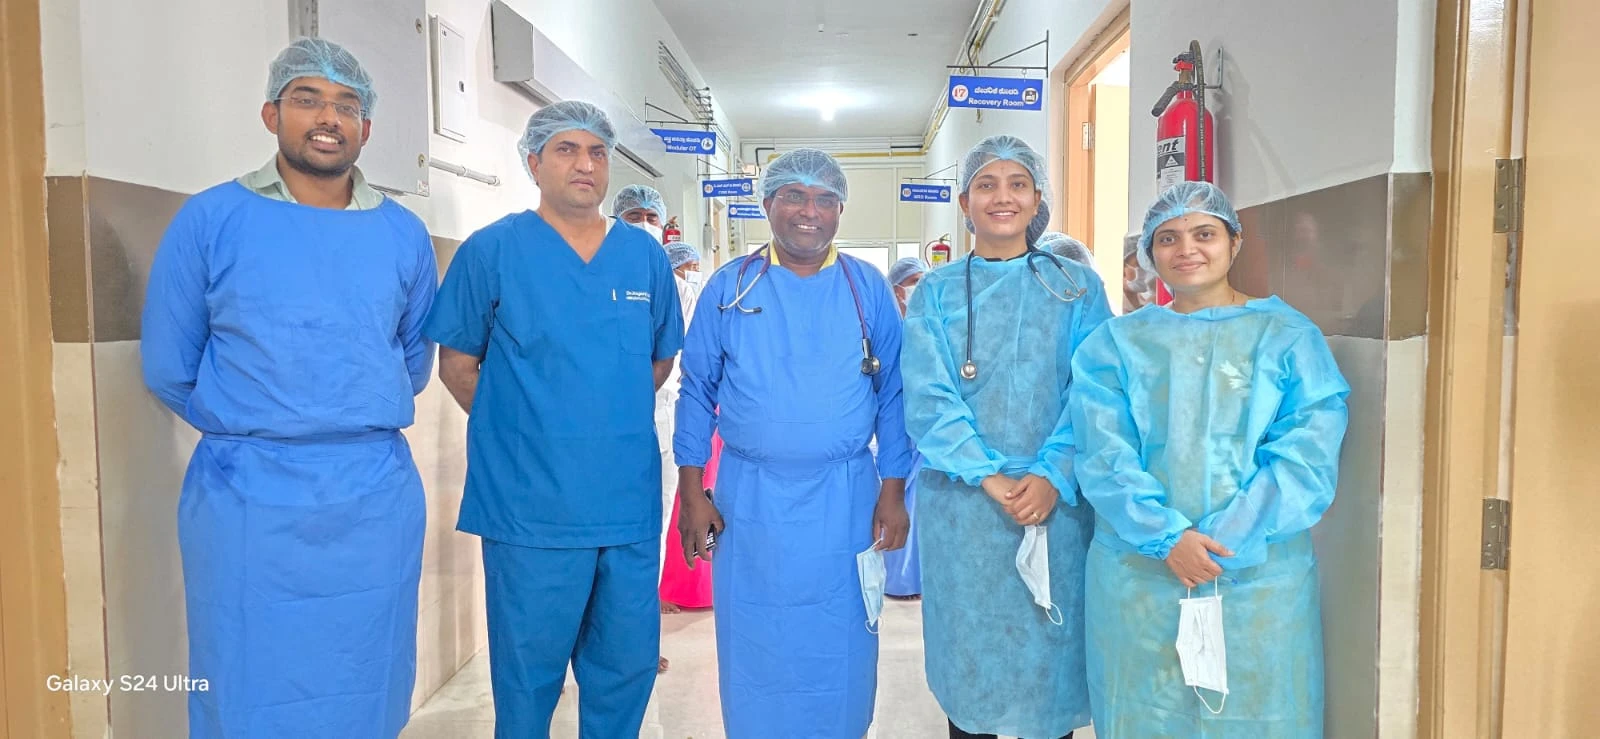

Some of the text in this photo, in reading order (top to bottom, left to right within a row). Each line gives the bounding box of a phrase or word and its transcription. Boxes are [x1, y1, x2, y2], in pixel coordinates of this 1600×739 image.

[954, 88, 966, 98] 17
[968, 98, 1024, 108] Recovery Room
